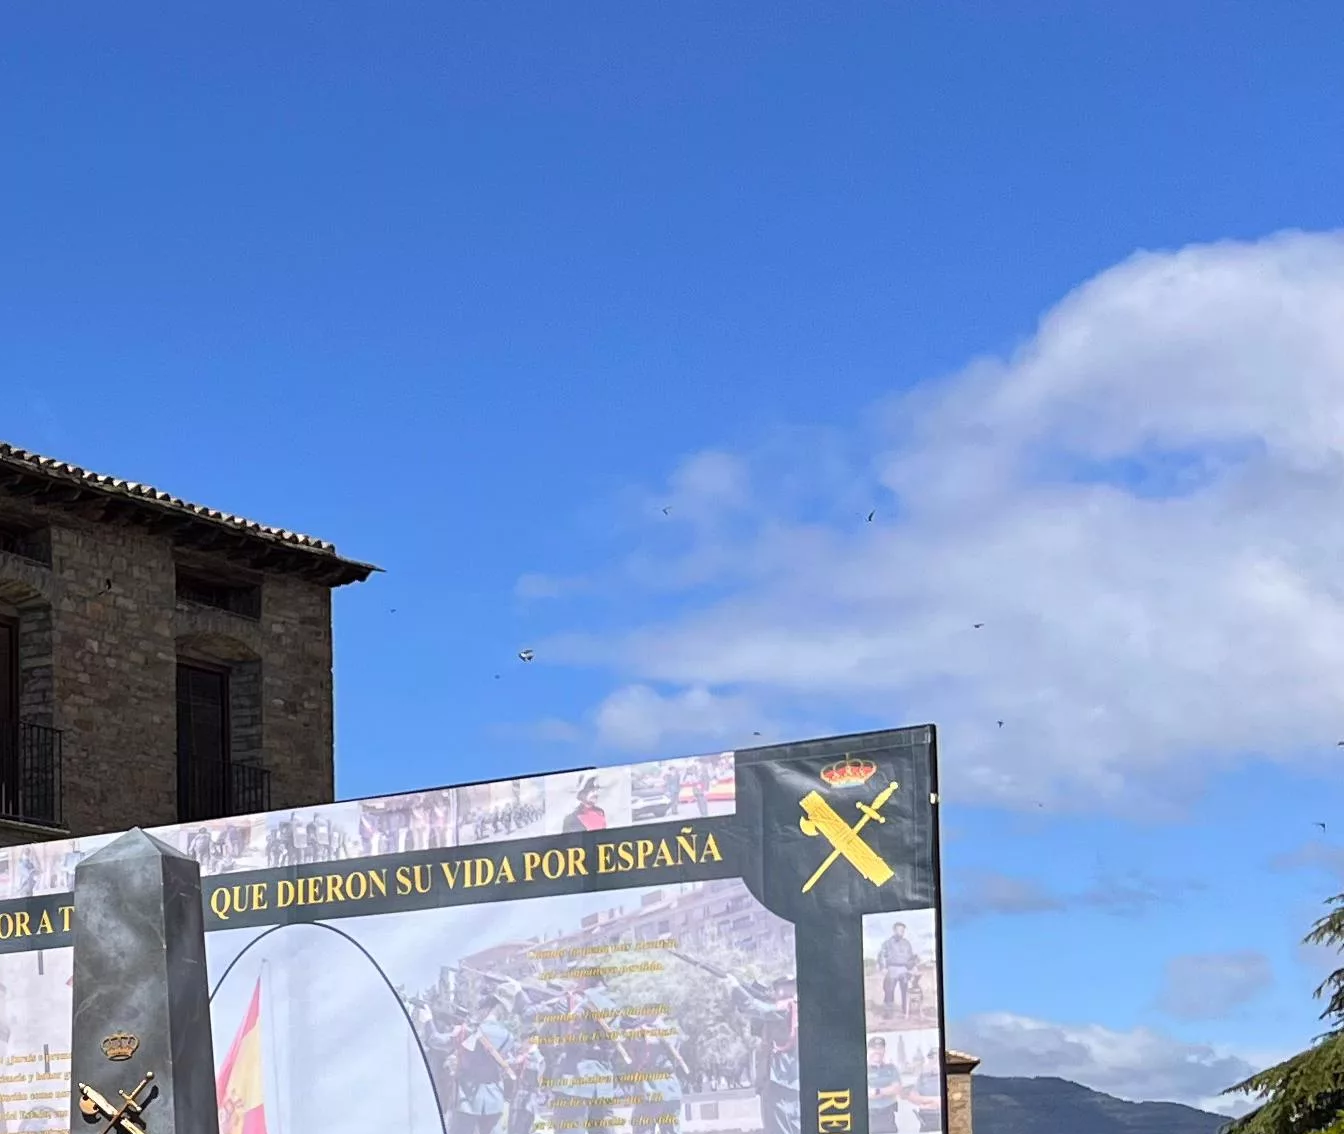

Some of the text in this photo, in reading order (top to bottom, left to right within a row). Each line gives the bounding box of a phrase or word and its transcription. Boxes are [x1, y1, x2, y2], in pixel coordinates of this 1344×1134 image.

[36, 909, 54, 935] A
[210, 883, 268, 920] QUE
[277, 868, 388, 907] DIERON
[395, 863, 432, 896] SU
[440, 855, 515, 890] VIDA
[523, 845, 589, 881] POR
[597, 826, 724, 875] ESPAÑA
